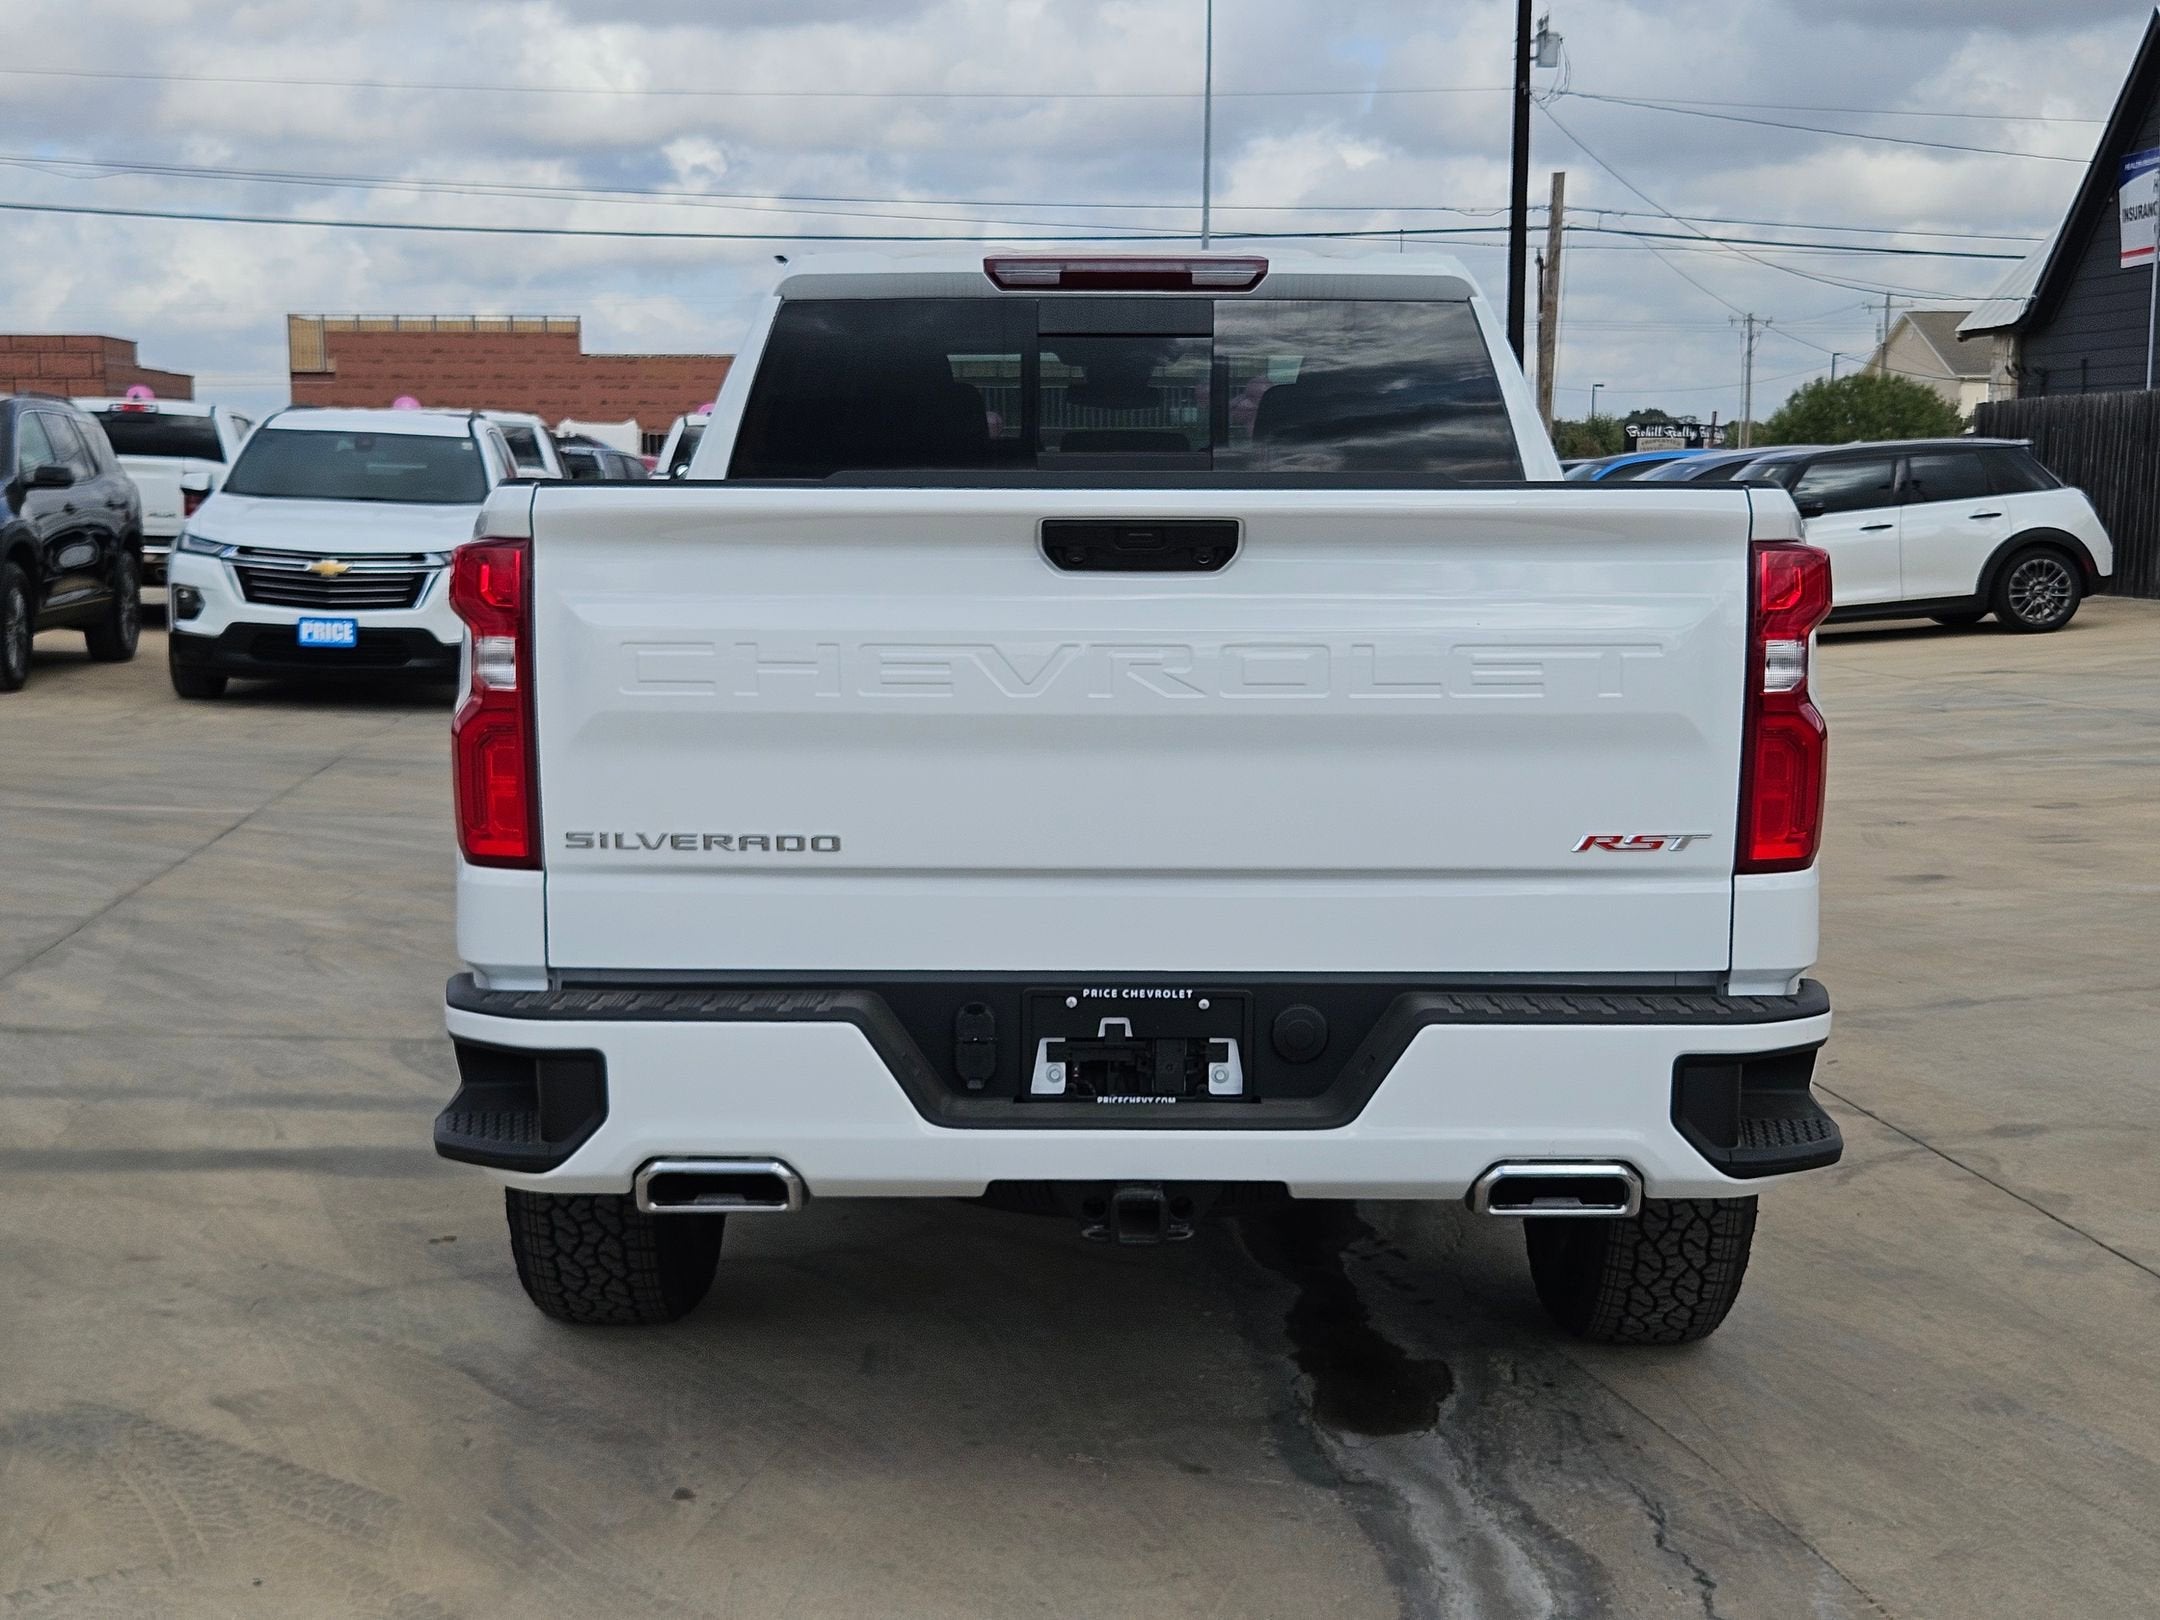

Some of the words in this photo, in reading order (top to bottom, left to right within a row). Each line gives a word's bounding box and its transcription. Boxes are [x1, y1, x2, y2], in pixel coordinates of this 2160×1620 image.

[301, 621, 355, 642] PRICE
[618, 641, 1664, 699] CHEVROLET
[564, 830, 842, 852] SILVERADO
[1570, 833, 1712, 852] RST
[1082, 988, 1118, 998] PRICE
[1121, 988, 1193, 999] CHEVROLET
[1096, 1095, 1176, 1104] PRICECHEVYCOM
